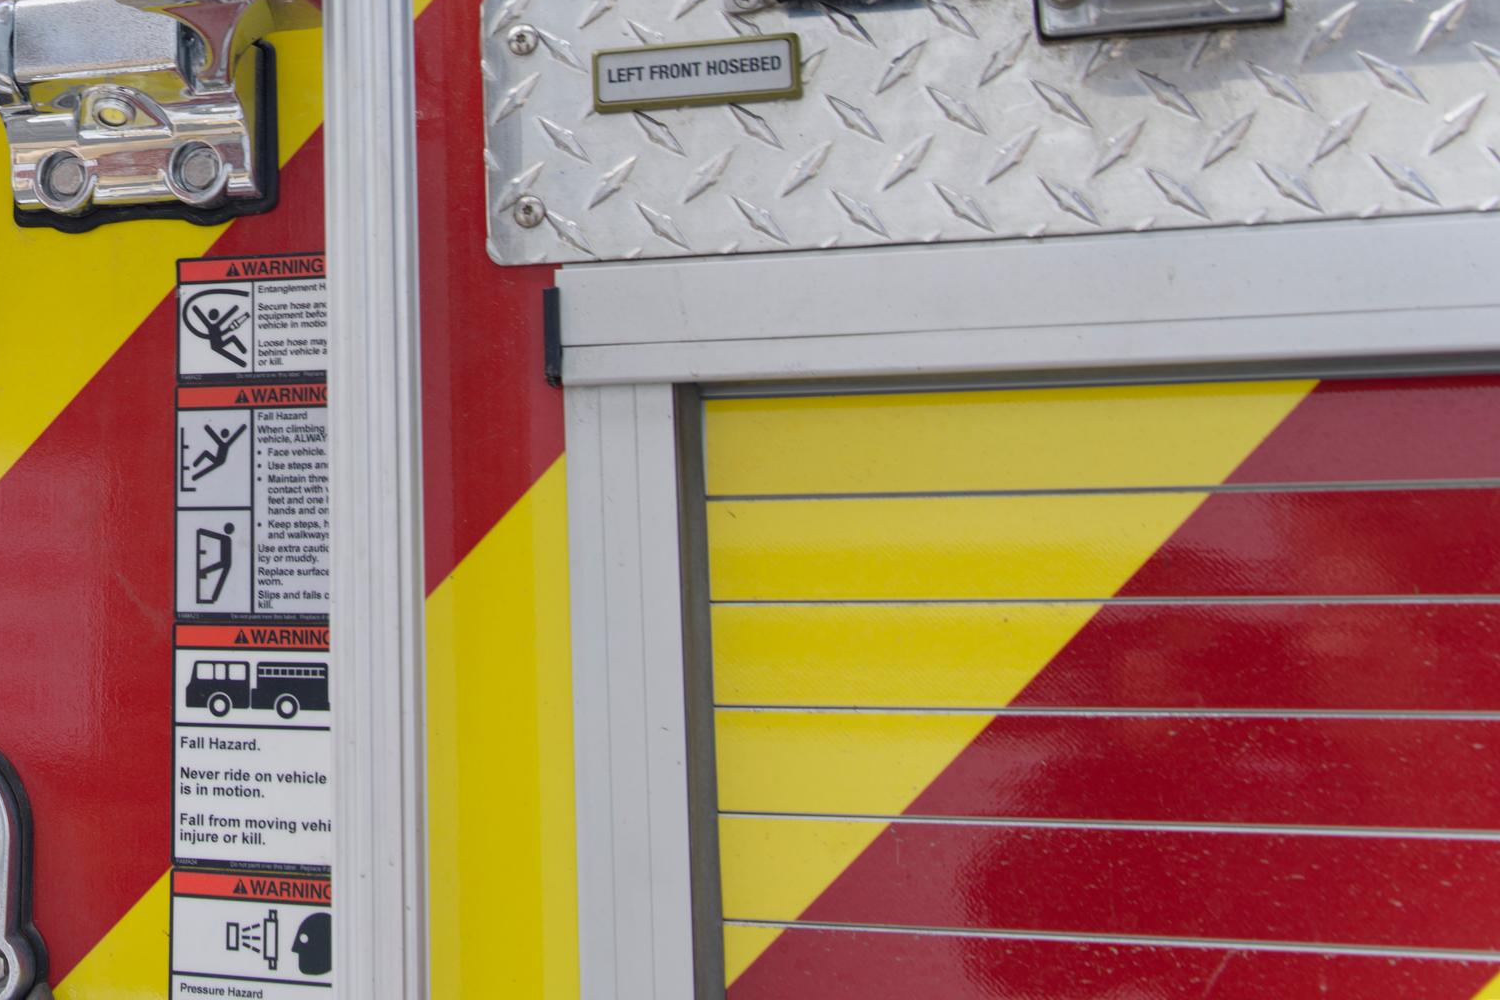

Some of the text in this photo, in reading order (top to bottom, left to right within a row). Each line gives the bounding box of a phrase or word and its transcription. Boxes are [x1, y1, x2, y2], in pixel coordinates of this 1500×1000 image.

[608, 55, 781, 84] LEFT FRONT HOSEBED
[242, 258, 324, 276] WARNING
[258, 284, 318, 294] Entanglement
[258, 302, 287, 311] Secure
[290, 302, 311, 310] hose
[258, 310, 327, 322] equipment befo
[258, 320, 327, 329] vehicle in motio
[258, 338, 327, 348] Loose hose may
[258, 348, 288, 356] behind
[289, 346, 320, 356] vehicle
[269, 357, 284, 366] kill.
[258, 411, 308, 420] Fall Hazard
[257, 424, 325, 436] When climbing
[257, 433, 327, 444] vehicle, ALWAY
[268, 447, 326, 456] Face vehicle.
[268, 462, 328, 472] Use steps an
[268, 474, 328, 483] Maintain thre
[268, 486, 302, 494] contact
[304, 484, 323, 494] with
[268, 496, 284, 504] feet
[287, 496, 304, 504] and
[268, 506, 296, 515] hands
[298, 506, 316, 515] and
[268, 520, 292, 530] Keep
[293, 520, 321, 530] steps,
[268, 531, 285, 540] and
[258, 544, 276, 552] Use
[278, 544, 301, 552] extra
[258, 554, 271, 564] icy
[286, 554, 319, 564] muddy.
[258, 566, 295, 578] Replace
[258, 578, 284, 586] worn.
[258, 590, 281, 600] Slips
[283, 591, 300, 600] and
[303, 590, 322, 600] falls
[258, 600, 274, 609] kill.
[180, 736, 261, 752] Fall Hazard.
[180, 766, 327, 785] Never ride on vehicle
[180, 783, 266, 798] is in motion.
[180, 813, 331, 834] Fall from moving vehi
[180, 829, 266, 846] injure or kill.
[180, 982, 264, 999] Pressure Hazard
